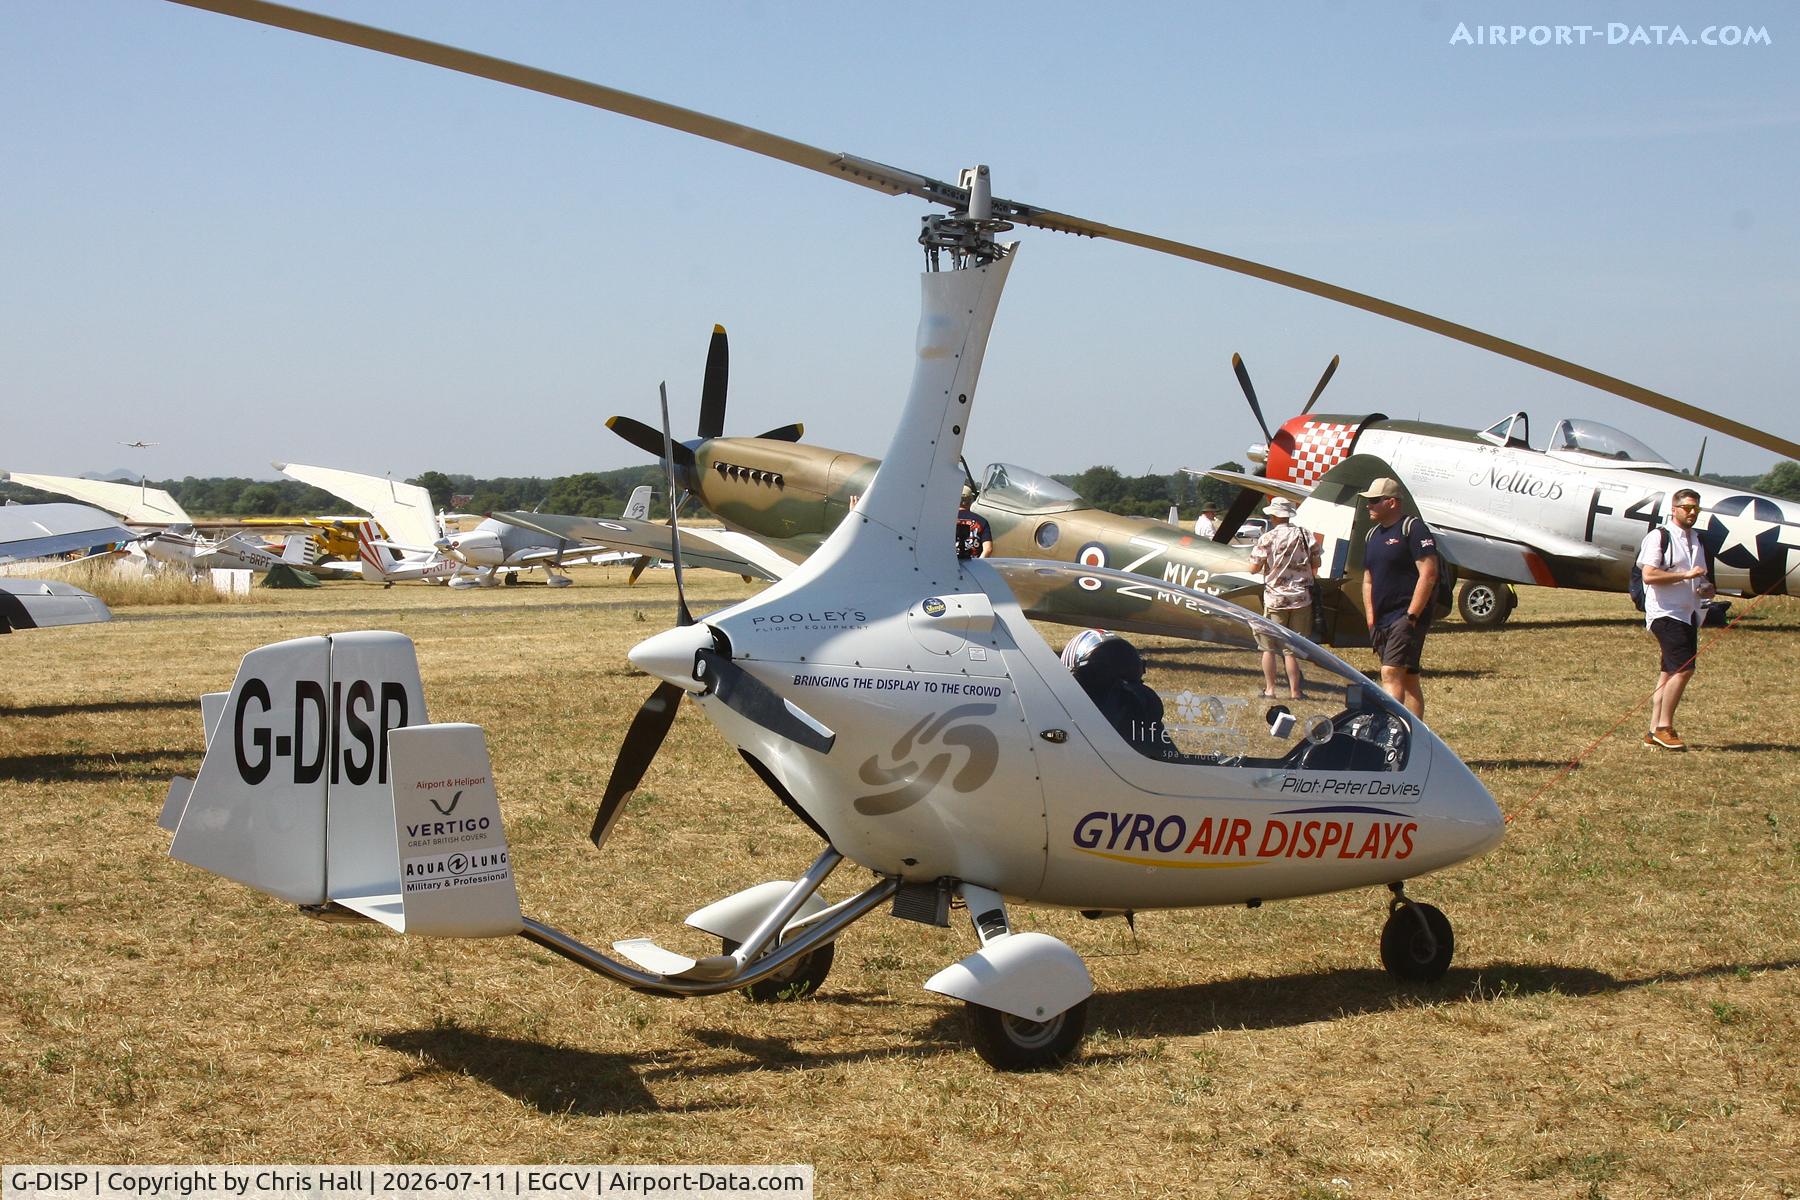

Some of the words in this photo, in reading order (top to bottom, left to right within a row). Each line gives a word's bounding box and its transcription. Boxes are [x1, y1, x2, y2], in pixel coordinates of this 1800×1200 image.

[239, 550, 272, 568] G-BRPF
[1163, 561, 1221, 596] MV2
[755, 625, 797, 633] FLIGHT
[793, 674, 849, 689] BRINGING
[853, 677, 874, 690] THE
[876, 679, 921, 692] DISPLAY
[924, 681, 938, 693] TO
[941, 683, 960, 695] THE
[962, 684, 1001, 698] CROWD
[234, 678, 409, 786] G-DISP
[416, 780, 445, 790] Airport
[446, 779, 454, 788] &
[454, 777, 486, 788] Heliport
[1322, 779, 1367, 795] Peter
[1367, 780, 1421, 796] Davies
[406, 817, 490, 838] VERTIGO
[1073, 811, 1187, 853] GYRO
[1184, 817, 1252, 857] AIR
[1256, 820, 1418, 860] DISPLAYS
[408, 839, 431, 848] GREAT
[433, 837, 459, 846] BRITISH
[460, 833, 488, 842] COVERS
[406, 862, 445, 876] AQUA
[471, 853, 507, 868] LUNG
[406, 880, 442, 892] Military
[444, 880, 451, 888] &
[453, 871, 508, 887] Professional
